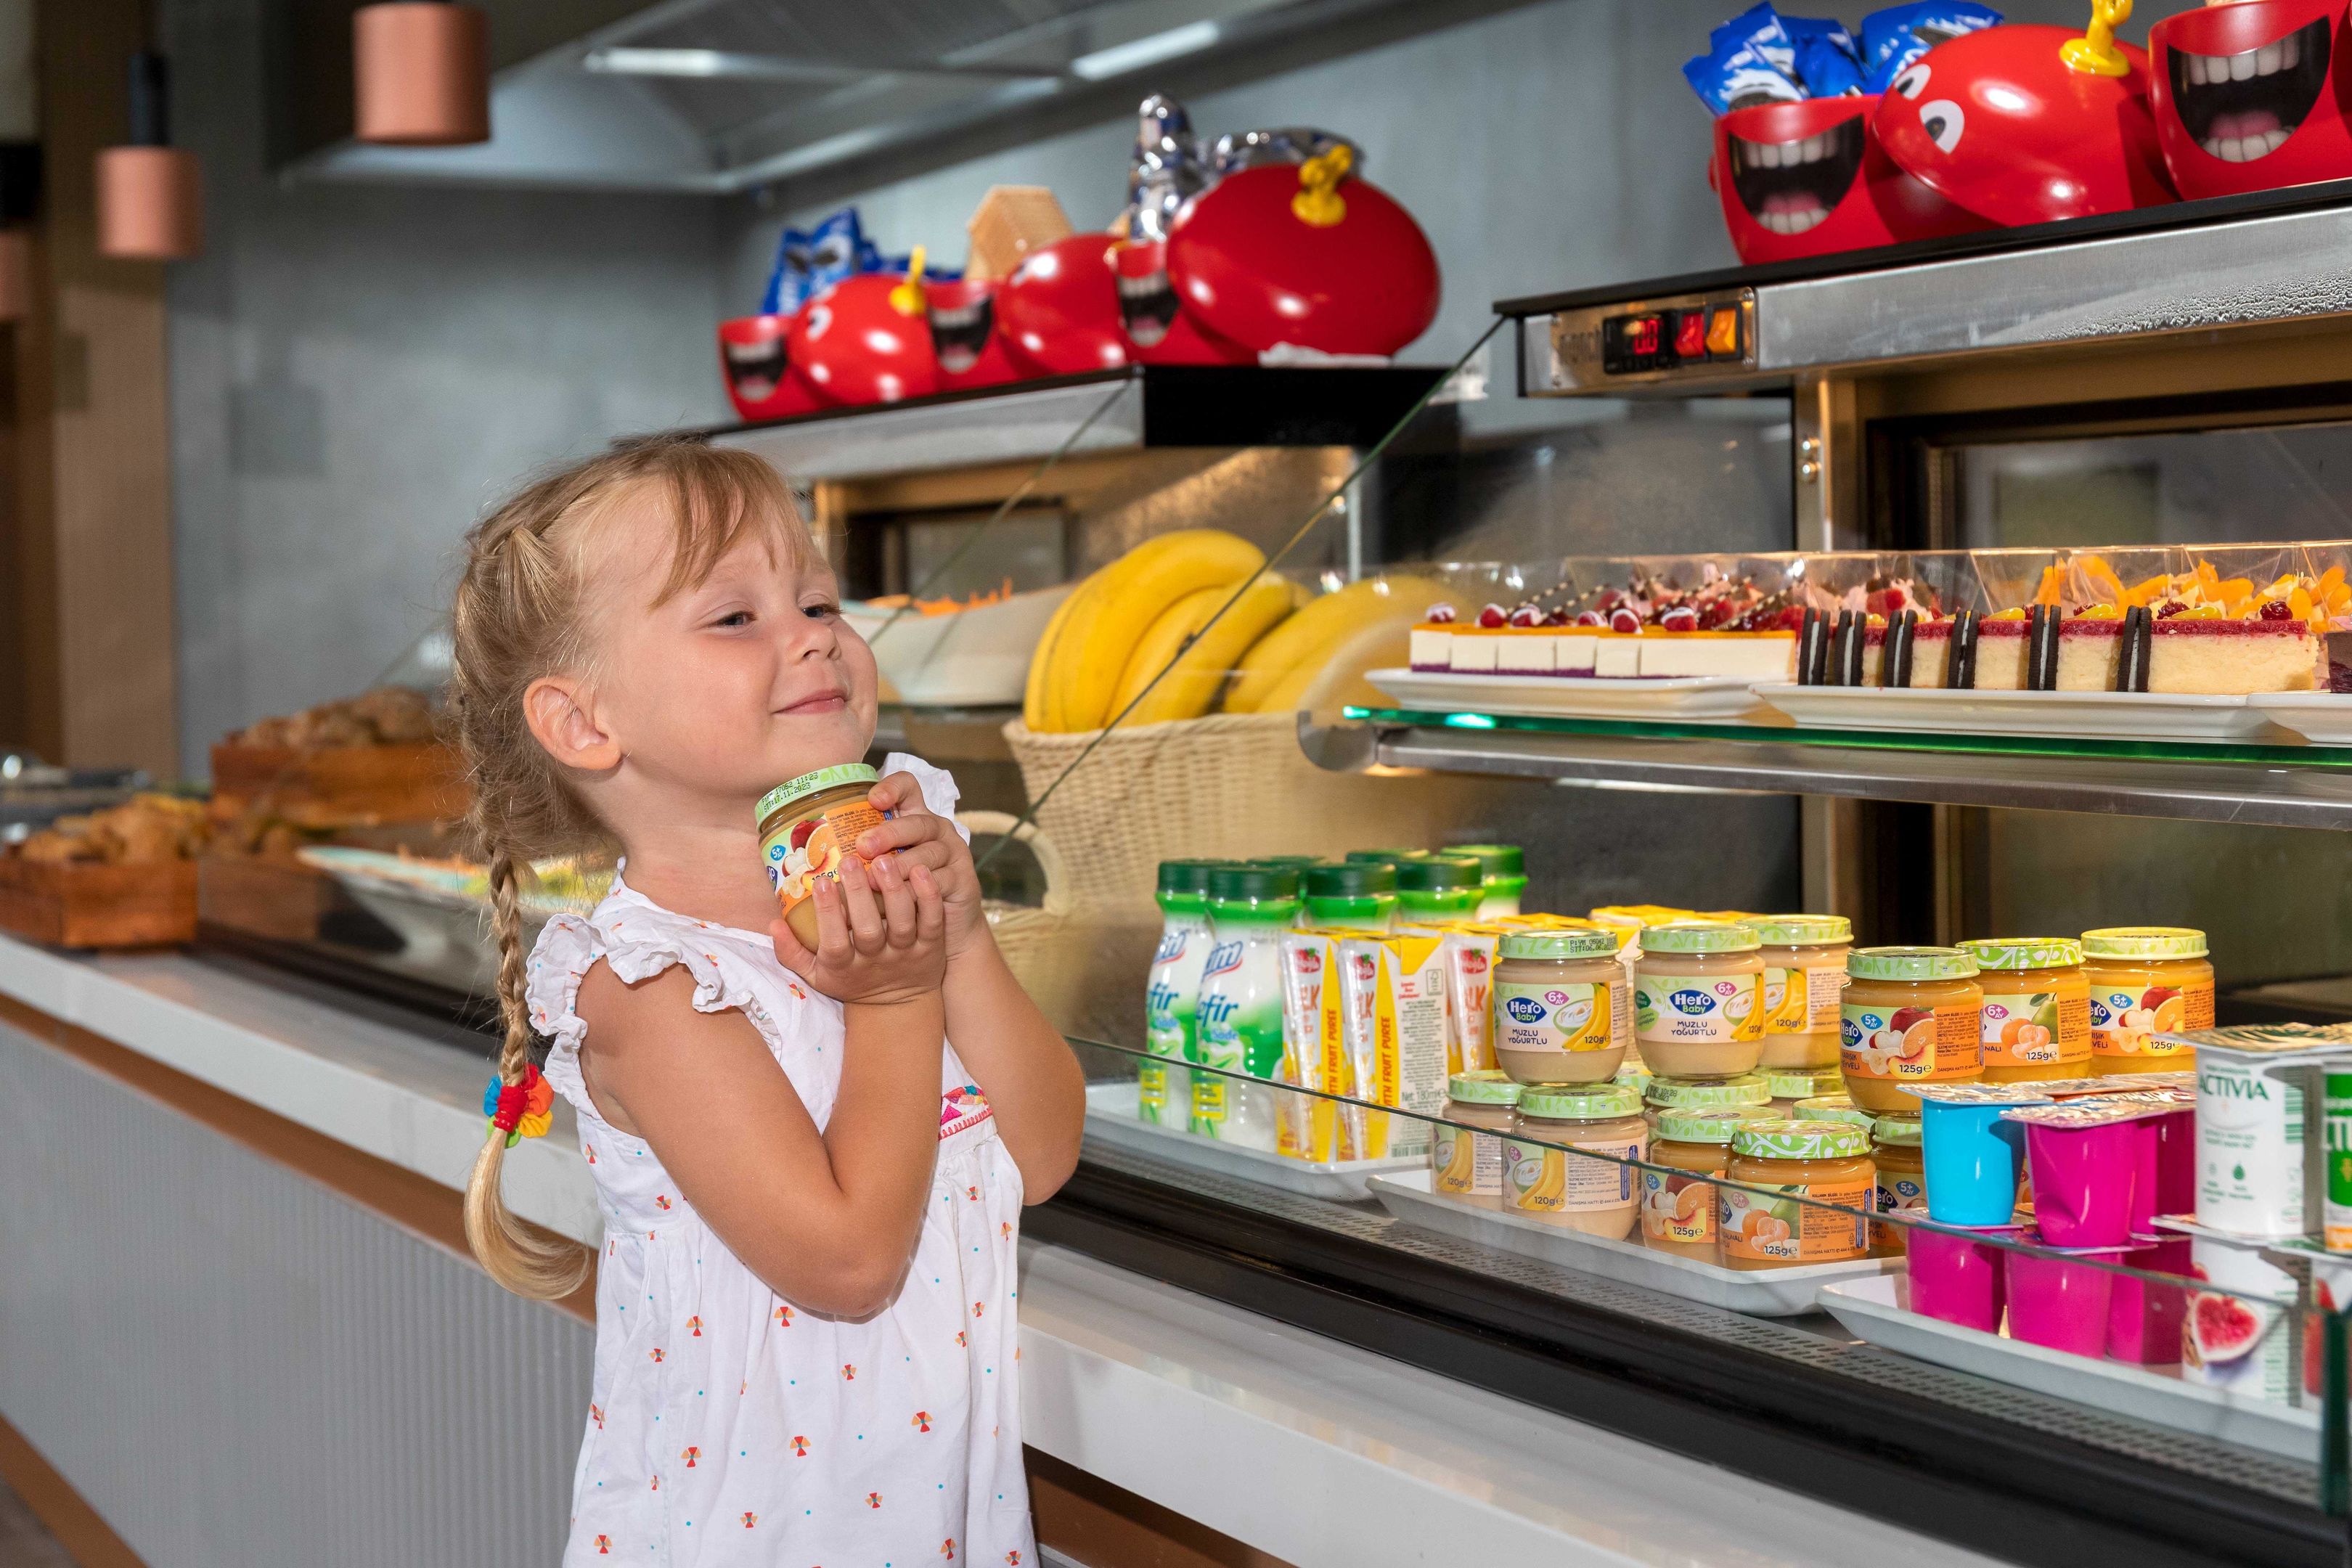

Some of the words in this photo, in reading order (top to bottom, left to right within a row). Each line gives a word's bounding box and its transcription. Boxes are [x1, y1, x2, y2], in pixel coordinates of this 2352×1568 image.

[796, 772, 819, 785] 11:23
[1718, 983, 1732, 992] 6+
[1548, 992, 1562, 1001] 6+
[1675, 993, 1711, 1005] Hero
[2113, 995, 2126, 1005] 5+
[1510, 1000, 1542, 1013] Hero
[1683, 1005, 1706, 1014] Baby
[1988, 1005, 2002, 1016] 6+
[2091, 1005, 2107, 1016] ero
[1516, 1013, 1537, 1022] Baby
[1865, 1016, 1877, 1025] 5+
[1328, 1009, 1337, 1040] PUREE
[1381, 1016, 1391, 1049] PUREE
[1671, 1027, 1717, 1036] YOĞURTLU
[1508, 1035, 1548, 1045] YOĞURTLU
[1328, 1044, 1337, 1073] FRUIT
[1382, 1053, 1392, 1083] FRUIT
[2199, 1074, 2269, 1101] ACTIVIA
[1900, 1183, 1913, 1192] 5+
[1877, 1191, 1893, 1204] ero
